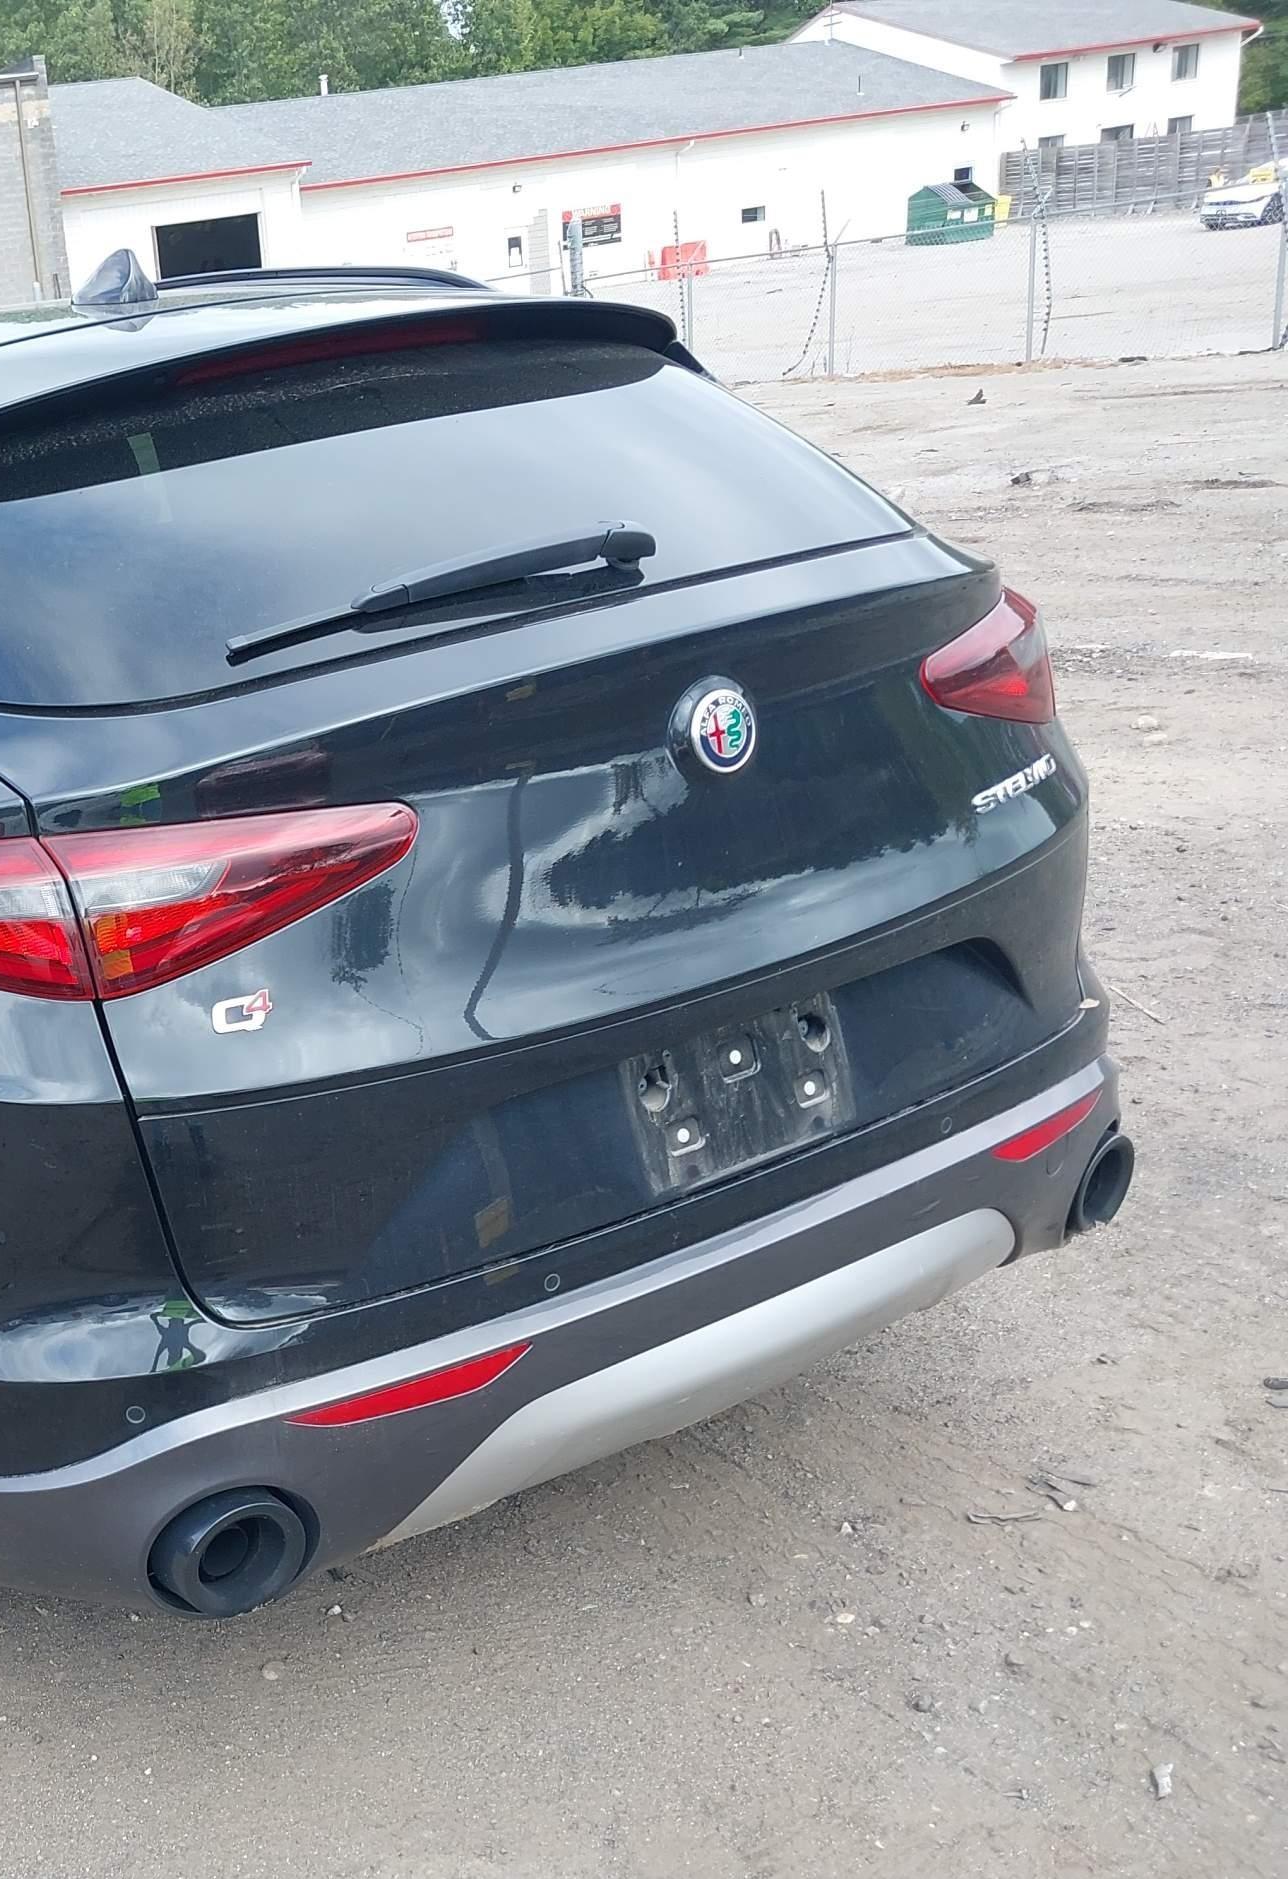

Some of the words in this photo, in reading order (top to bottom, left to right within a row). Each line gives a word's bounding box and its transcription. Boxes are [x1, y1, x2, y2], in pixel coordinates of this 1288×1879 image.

[572, 205, 611, 218] WARNING
[700, 702, 717, 737] ALFA
[718, 696, 752, 727] ROMEO
[971, 753, 1056, 814] STELVIO
[211, 988, 273, 1034] Q4
